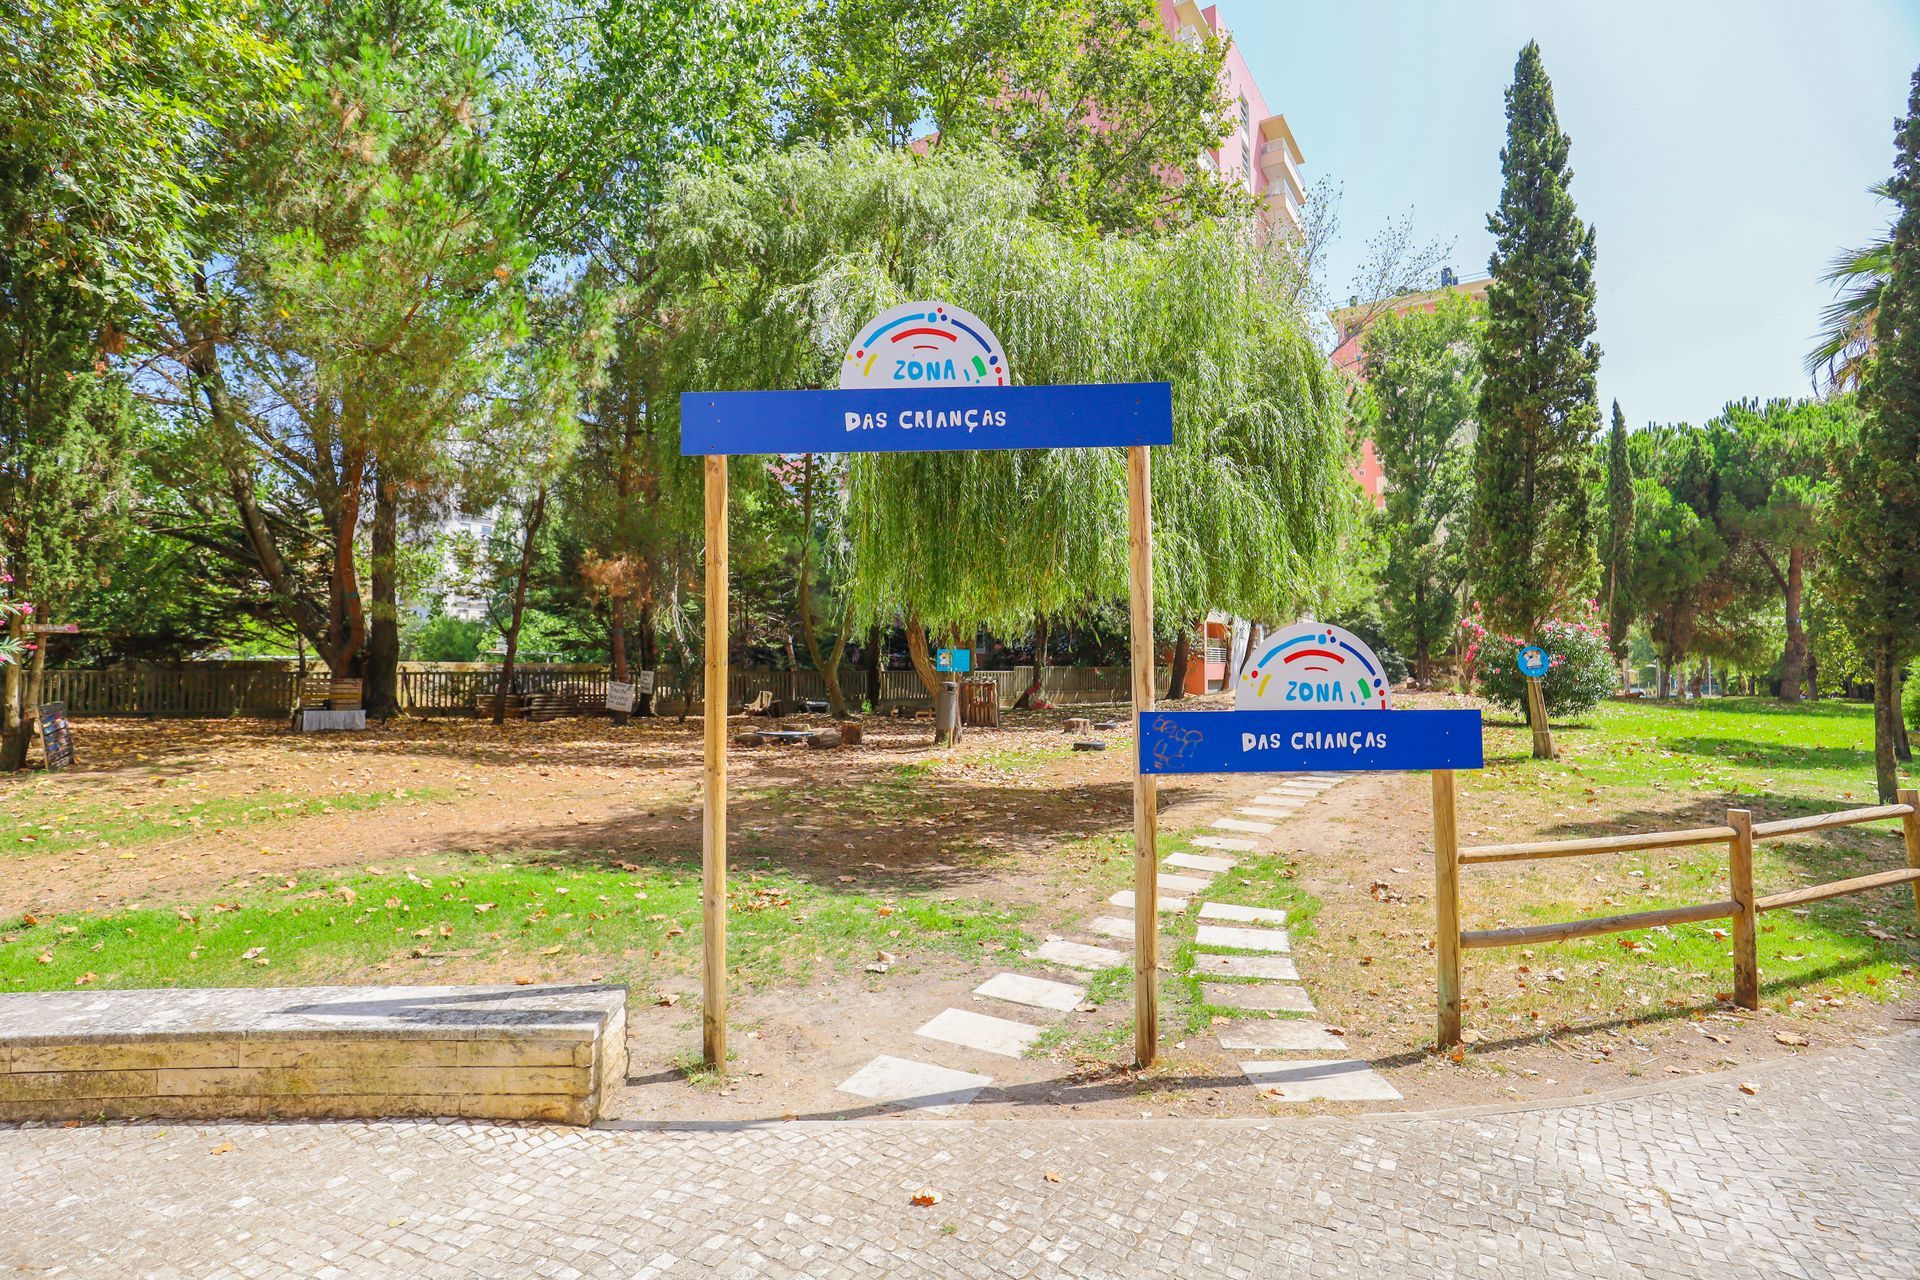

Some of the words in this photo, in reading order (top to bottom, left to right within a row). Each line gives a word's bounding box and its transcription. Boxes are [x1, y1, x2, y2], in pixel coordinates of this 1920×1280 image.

[893, 359, 957, 382] ZONA
[844, 411, 888, 432] DAS
[898, 409, 1007, 433] CRIANÇAS
[1285, 680, 1344, 702] ZONA
[1241, 732, 1281, 752] DAS
[1291, 731, 1387, 754] CRIANÇAS
